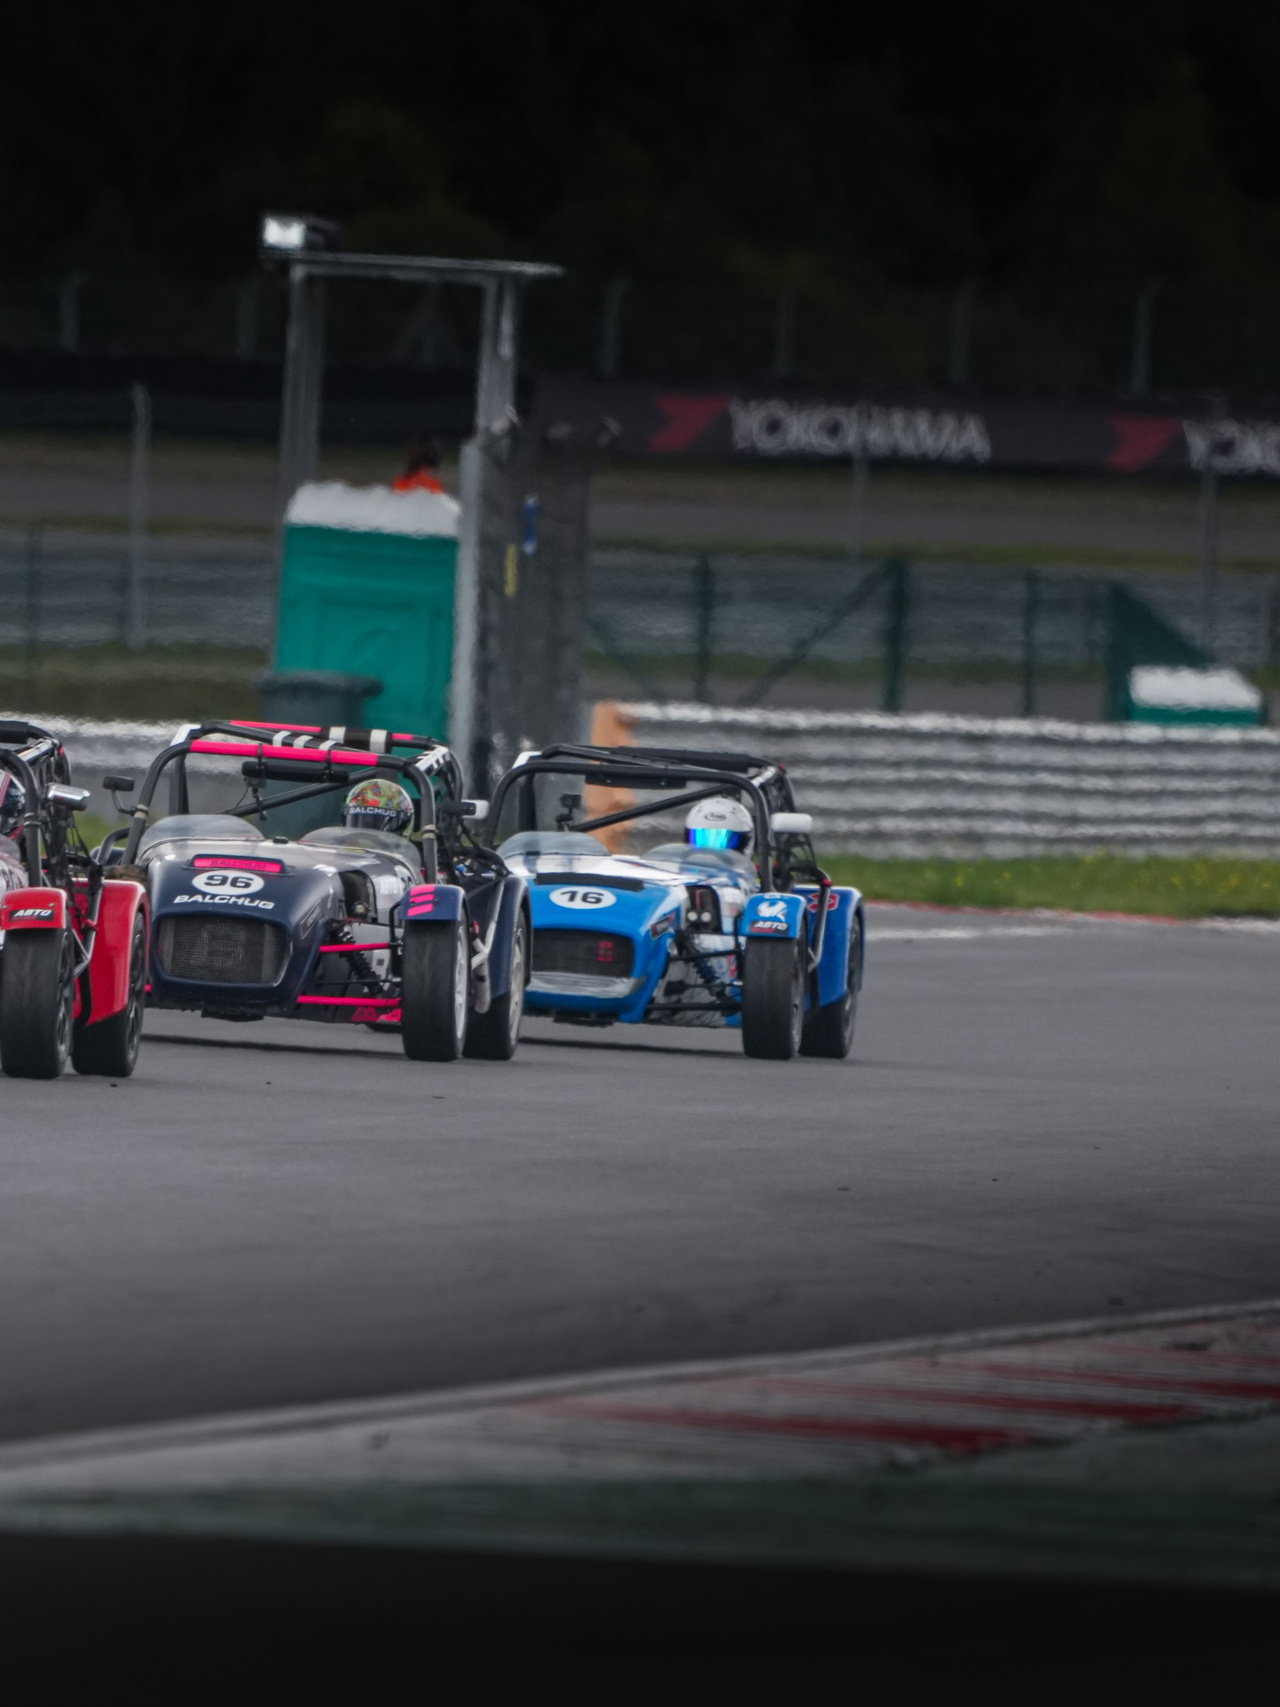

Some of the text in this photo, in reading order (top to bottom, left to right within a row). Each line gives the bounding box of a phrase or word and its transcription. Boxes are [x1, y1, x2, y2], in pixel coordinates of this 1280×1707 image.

[349, 806, 397, 817] BALCHUG
[203, 874, 254, 889] 96
[173, 894, 275, 910] BALCHUG
[560, 890, 604, 905] 16
